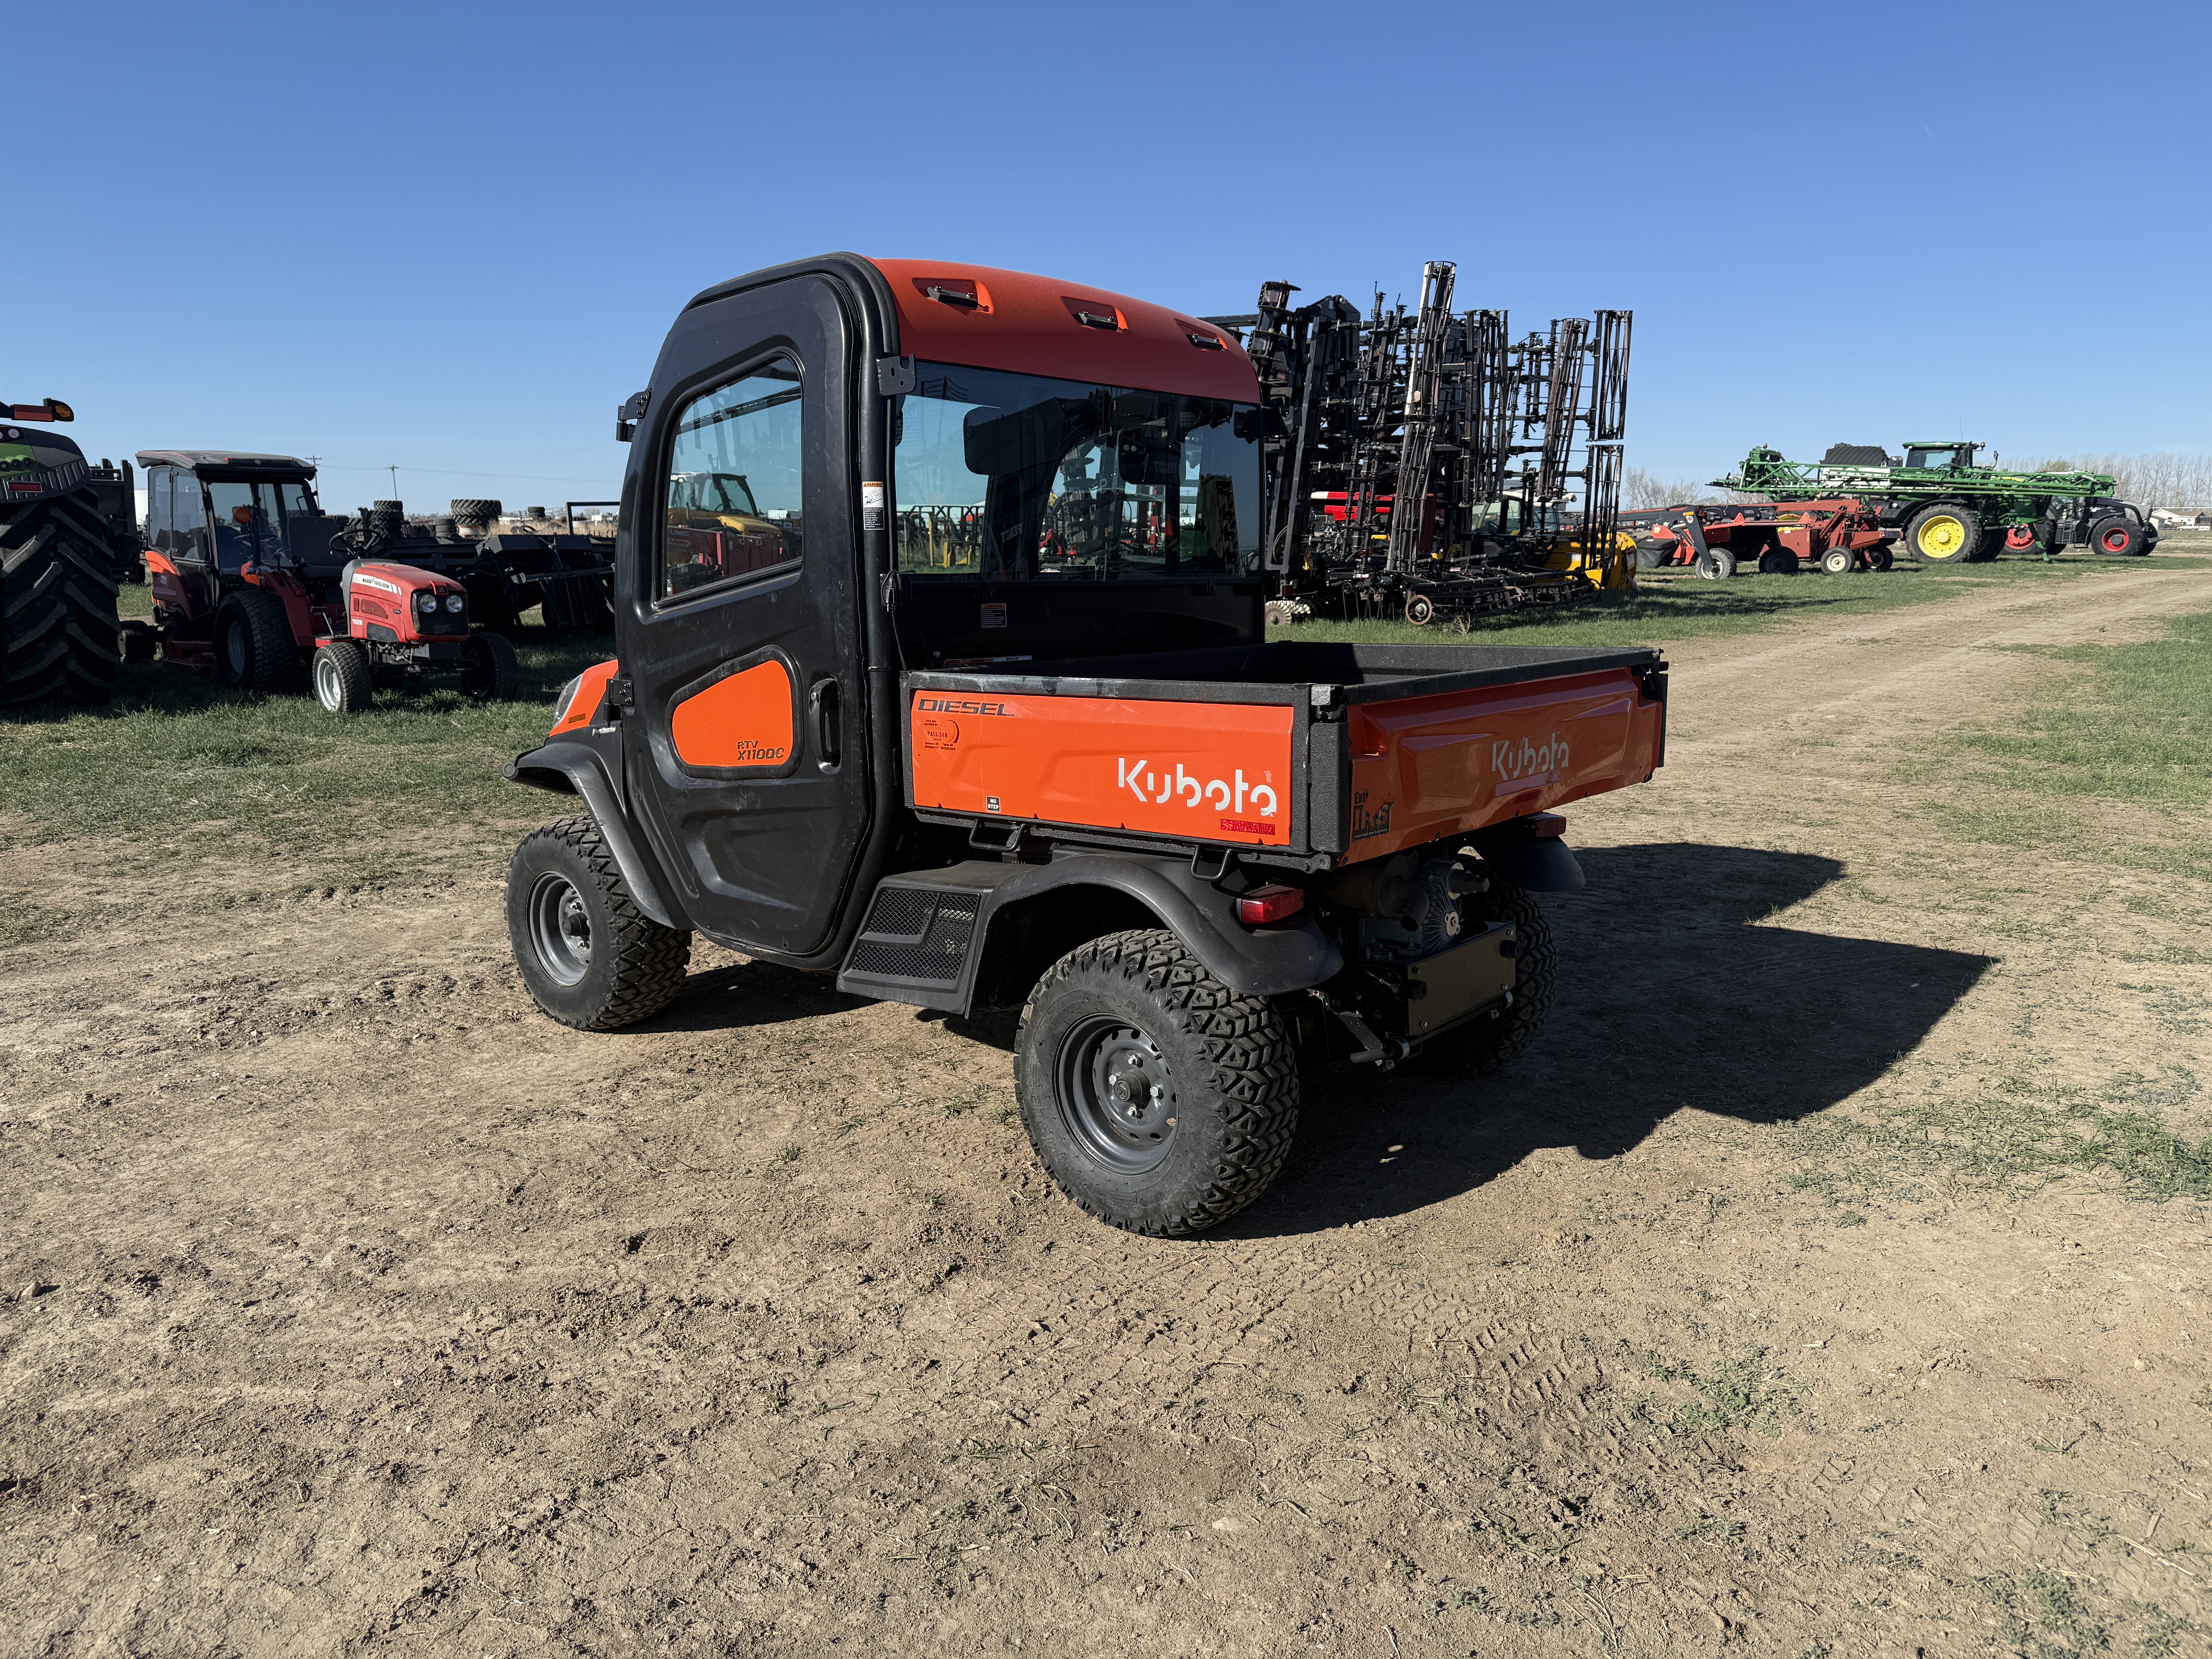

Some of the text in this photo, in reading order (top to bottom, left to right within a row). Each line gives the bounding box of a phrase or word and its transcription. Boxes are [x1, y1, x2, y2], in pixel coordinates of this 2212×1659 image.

[374, 580, 390, 589] FERGUSON
[917, 698, 1015, 717] DIESEL
[737, 740, 759, 749] RTV
[737, 747, 785, 761] X1100C
[1492, 732, 1570, 781] Kubota
[1118, 757, 1277, 817] Kubota
